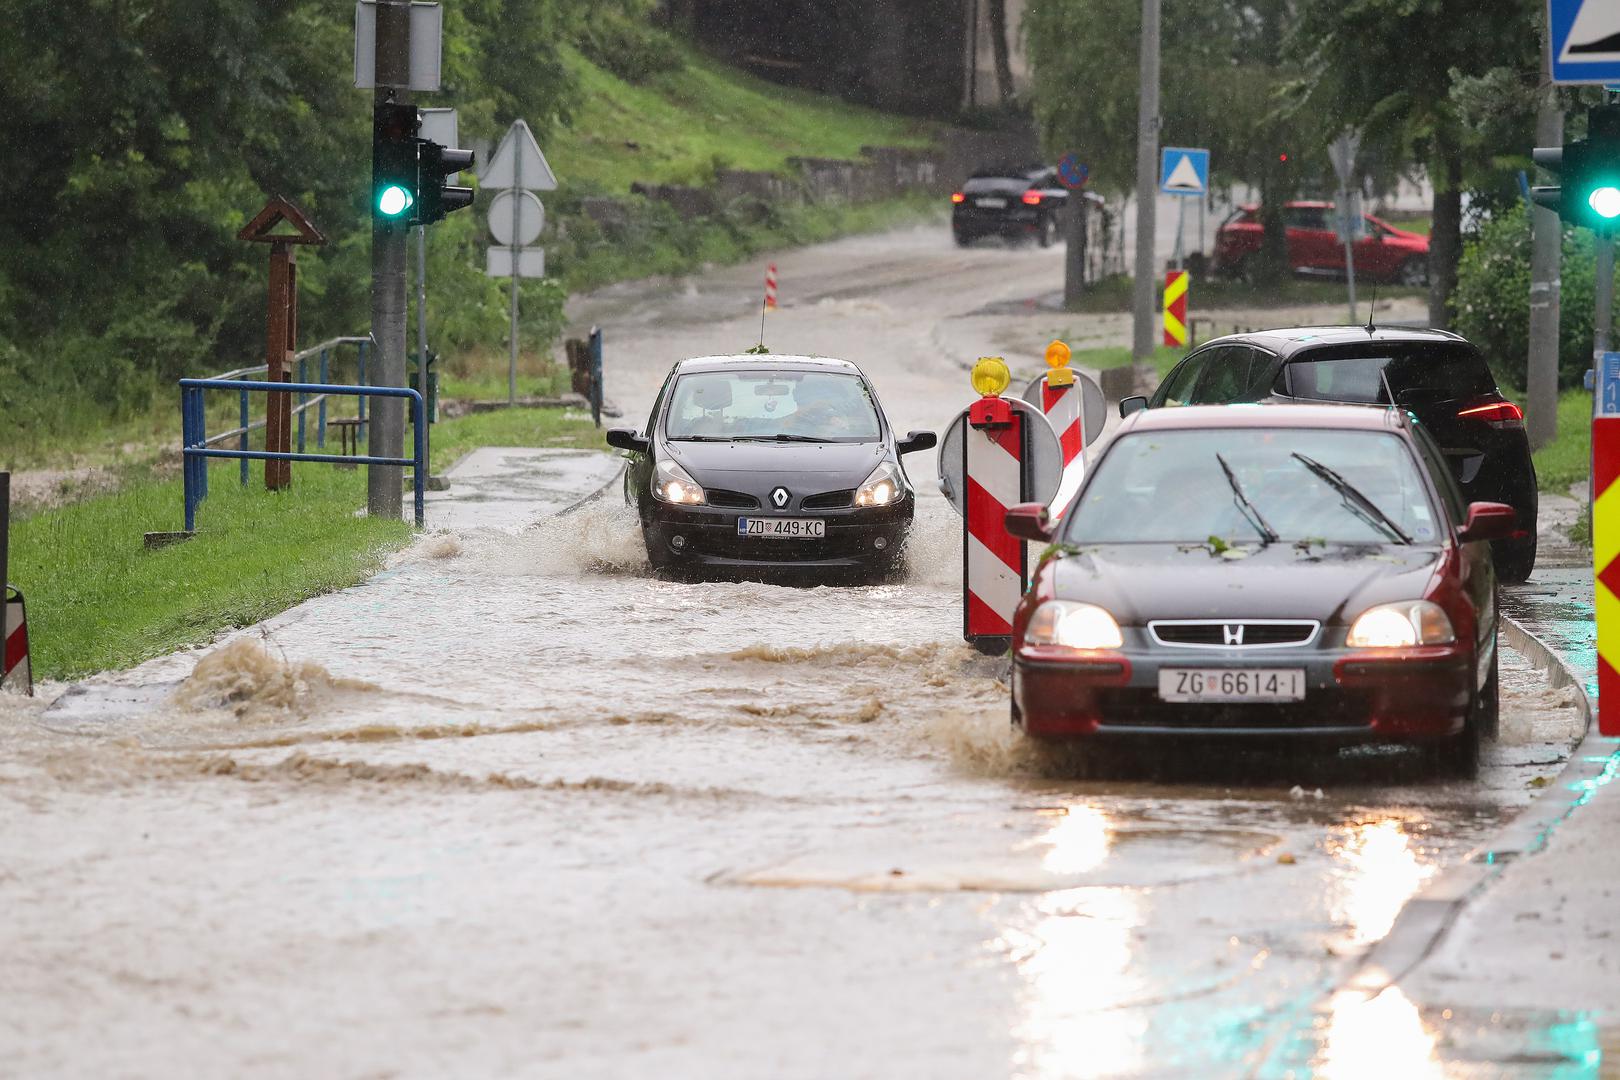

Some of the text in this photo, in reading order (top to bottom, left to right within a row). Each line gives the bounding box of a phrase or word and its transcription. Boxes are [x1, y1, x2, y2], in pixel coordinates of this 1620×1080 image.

[748, 520, 764, 534] ZD
[774, 521, 822, 535] 449-KC
[1176, 672, 1296, 695] ZG 6614-I
